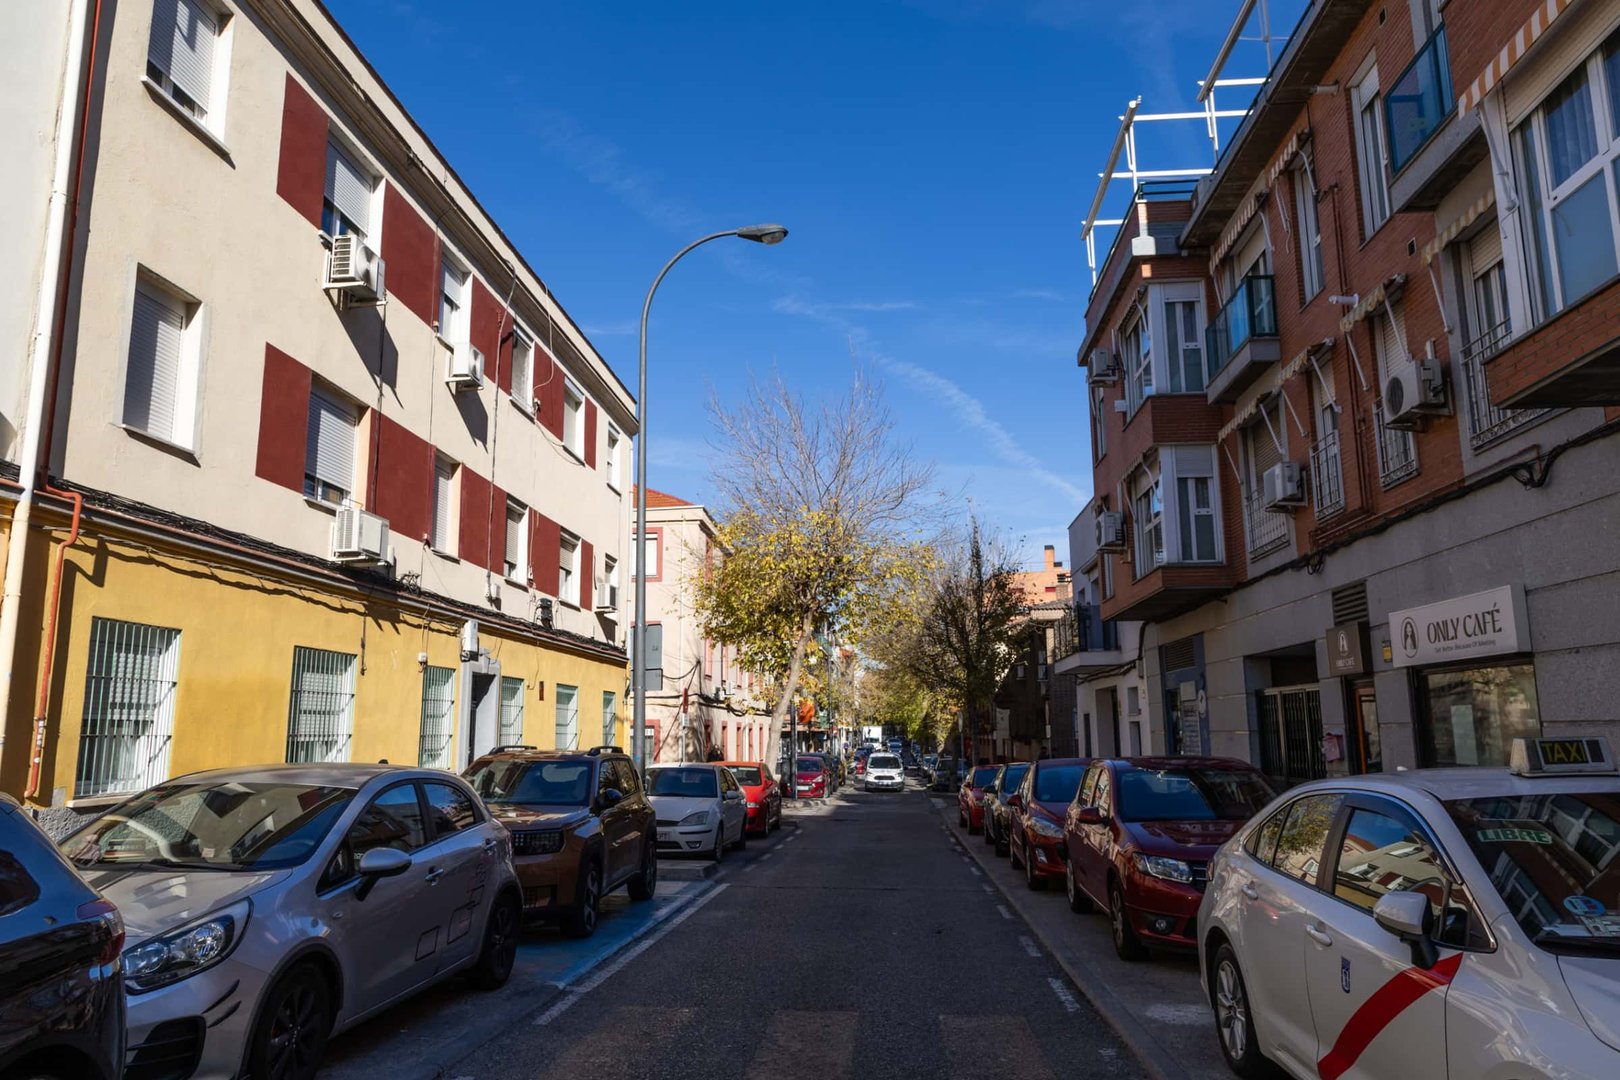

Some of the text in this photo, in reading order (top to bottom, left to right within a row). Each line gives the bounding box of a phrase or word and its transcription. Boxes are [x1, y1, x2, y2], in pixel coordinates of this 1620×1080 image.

[1427, 602, 1502, 644] ONLY CAFÉ
[1541, 742, 1587, 762] TAXI
[1480, 829, 1551, 843] LIBRE
